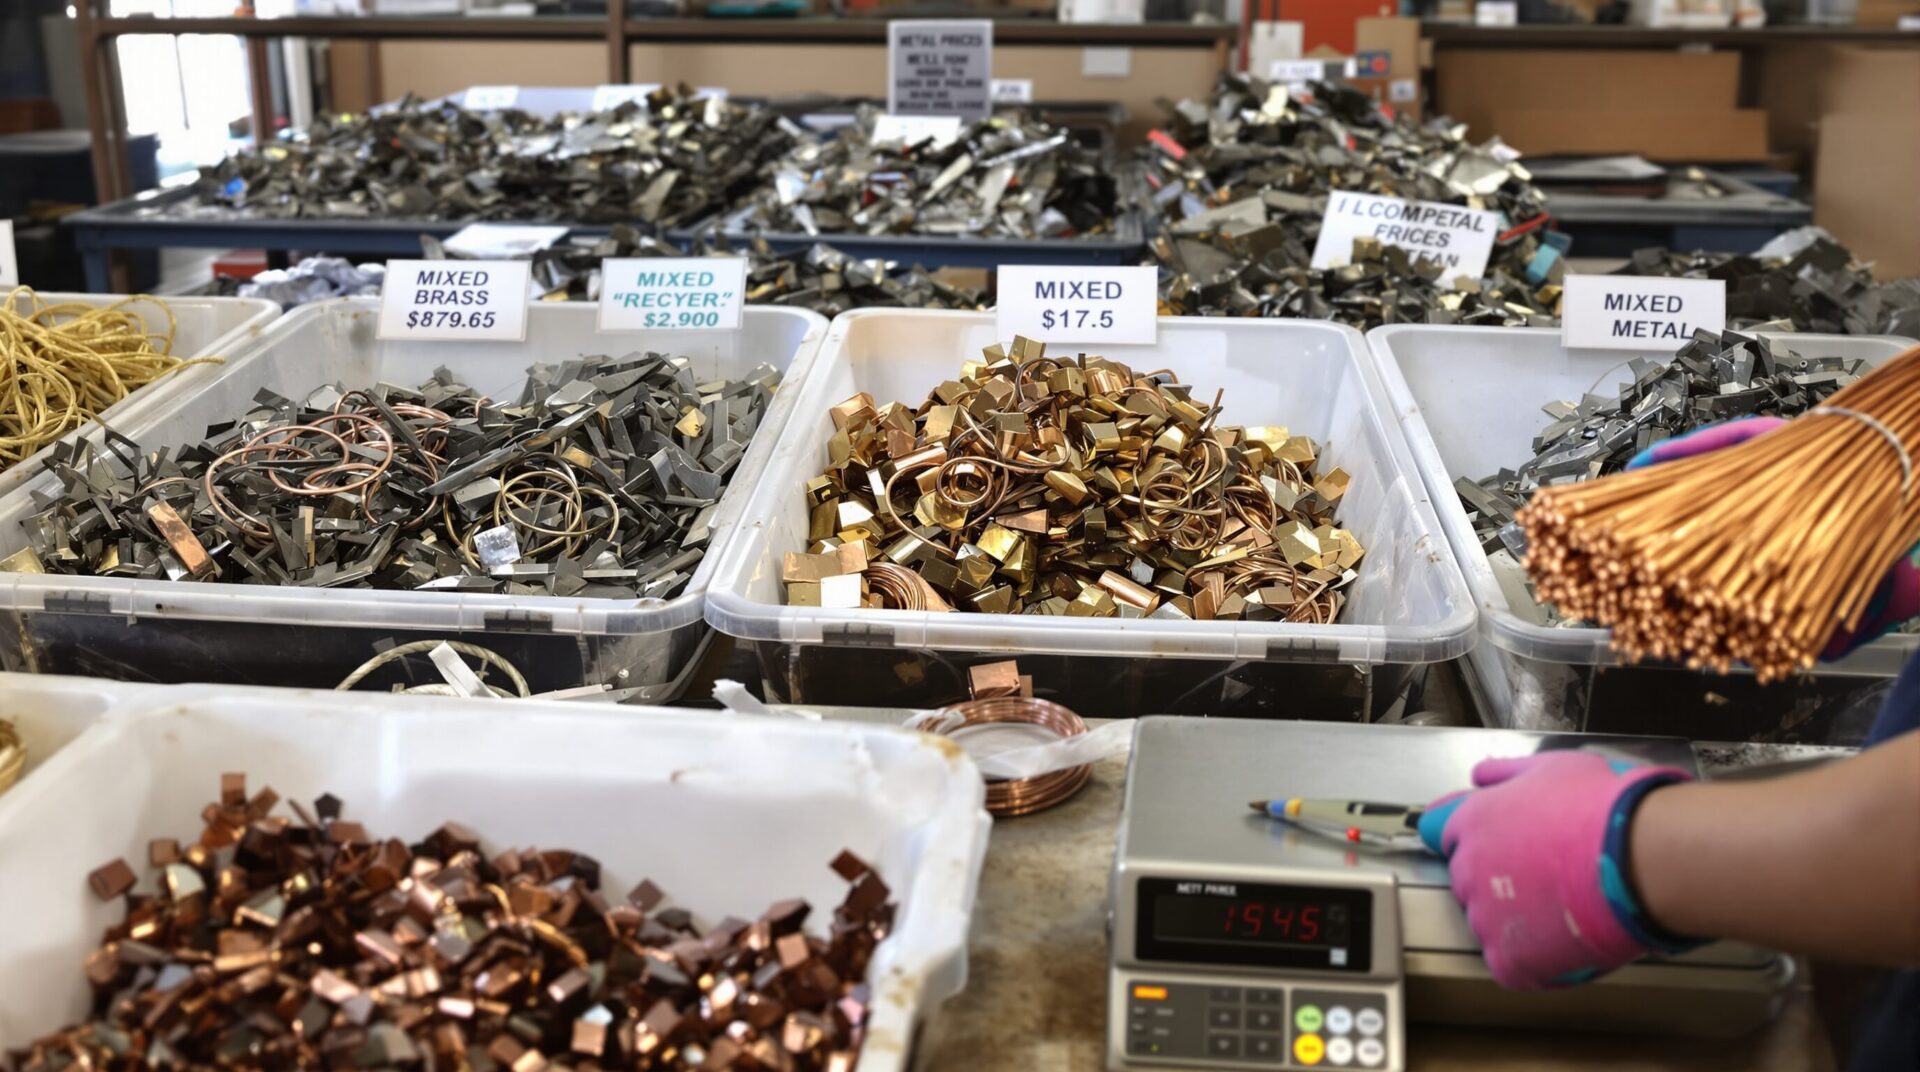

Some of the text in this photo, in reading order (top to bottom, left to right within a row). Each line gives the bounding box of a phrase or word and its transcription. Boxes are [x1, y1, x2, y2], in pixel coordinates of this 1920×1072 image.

[416, 270, 489, 286] MIXED
[637, 271, 714, 287] MIXED
[414, 289, 489, 305] BRASS
[1035, 281, 1122, 300] MIXED
[1604, 293, 1683, 313] MIXED
[406, 310, 496, 330] $879.65
[643, 311, 719, 328] $2.900
[1042, 309, 1114, 330] $17.5
[1612, 319, 1694, 340] METAL
